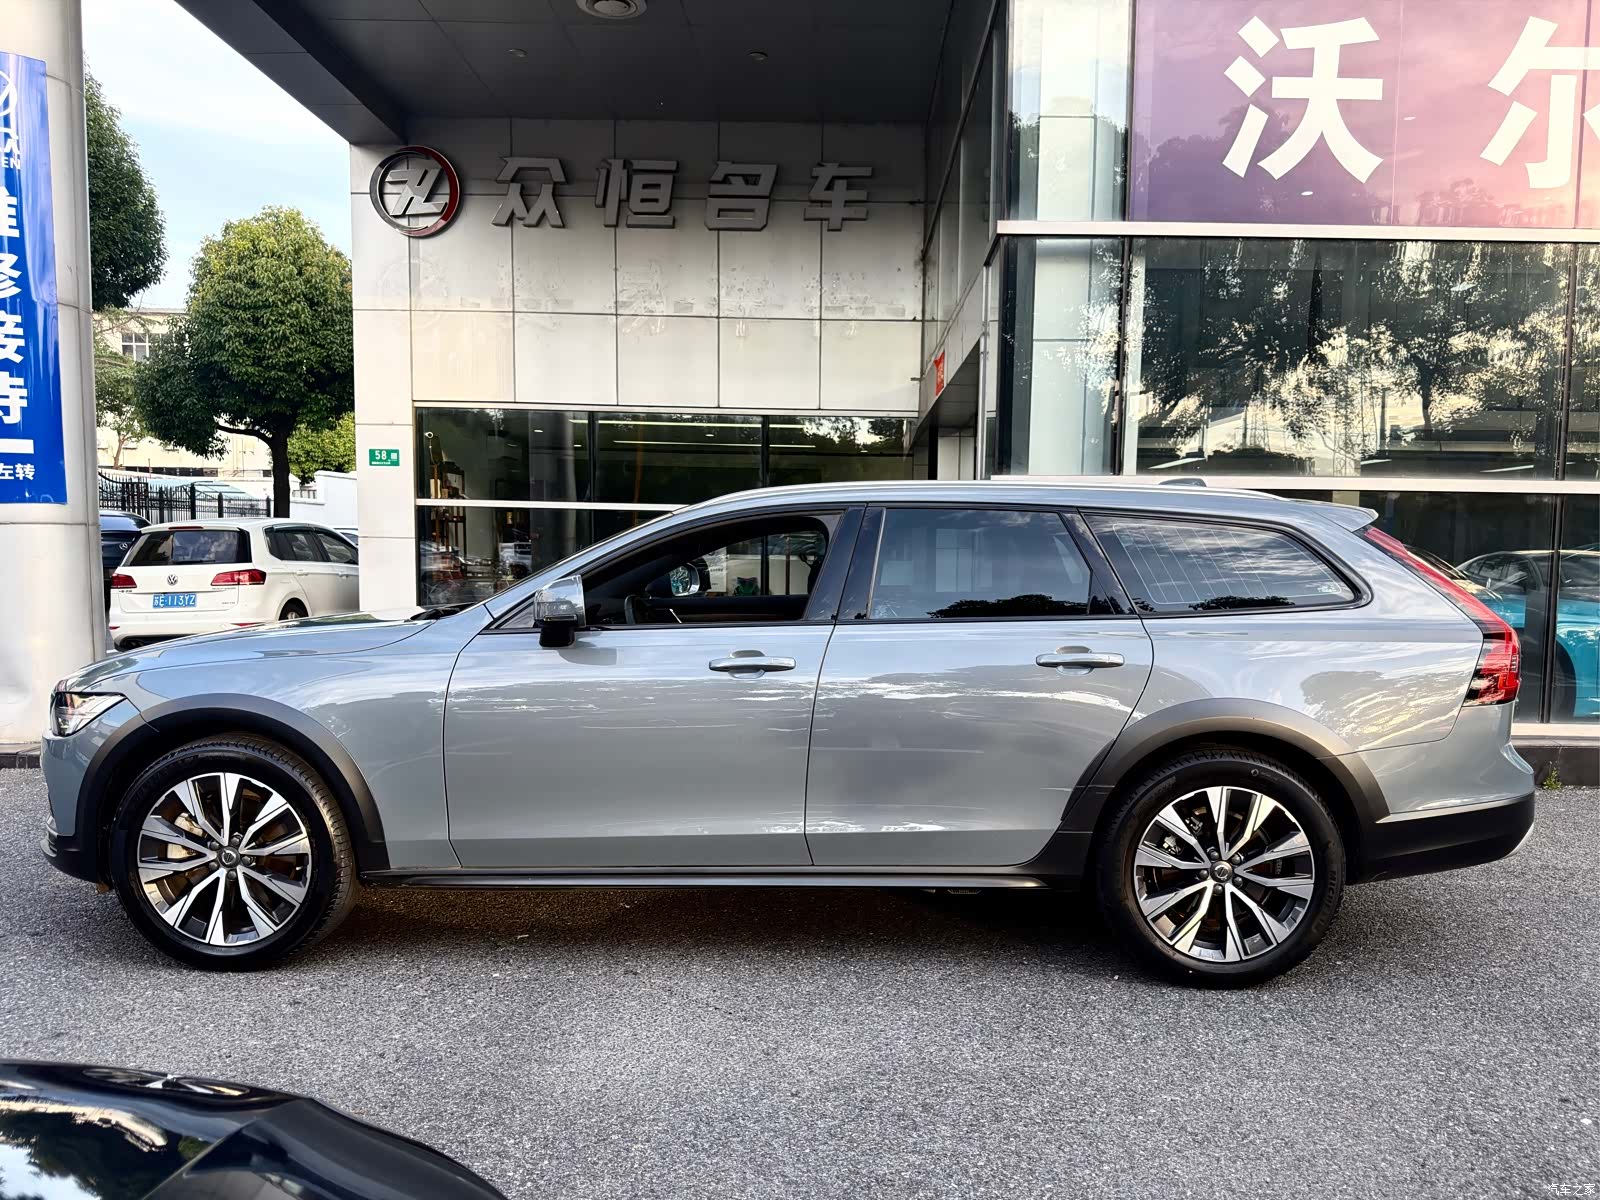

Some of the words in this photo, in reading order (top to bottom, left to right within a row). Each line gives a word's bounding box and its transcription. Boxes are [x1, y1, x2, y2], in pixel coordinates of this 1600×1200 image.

[491, 156, 873, 231] 众恒名车
[375, 450, 387, 460] 58
